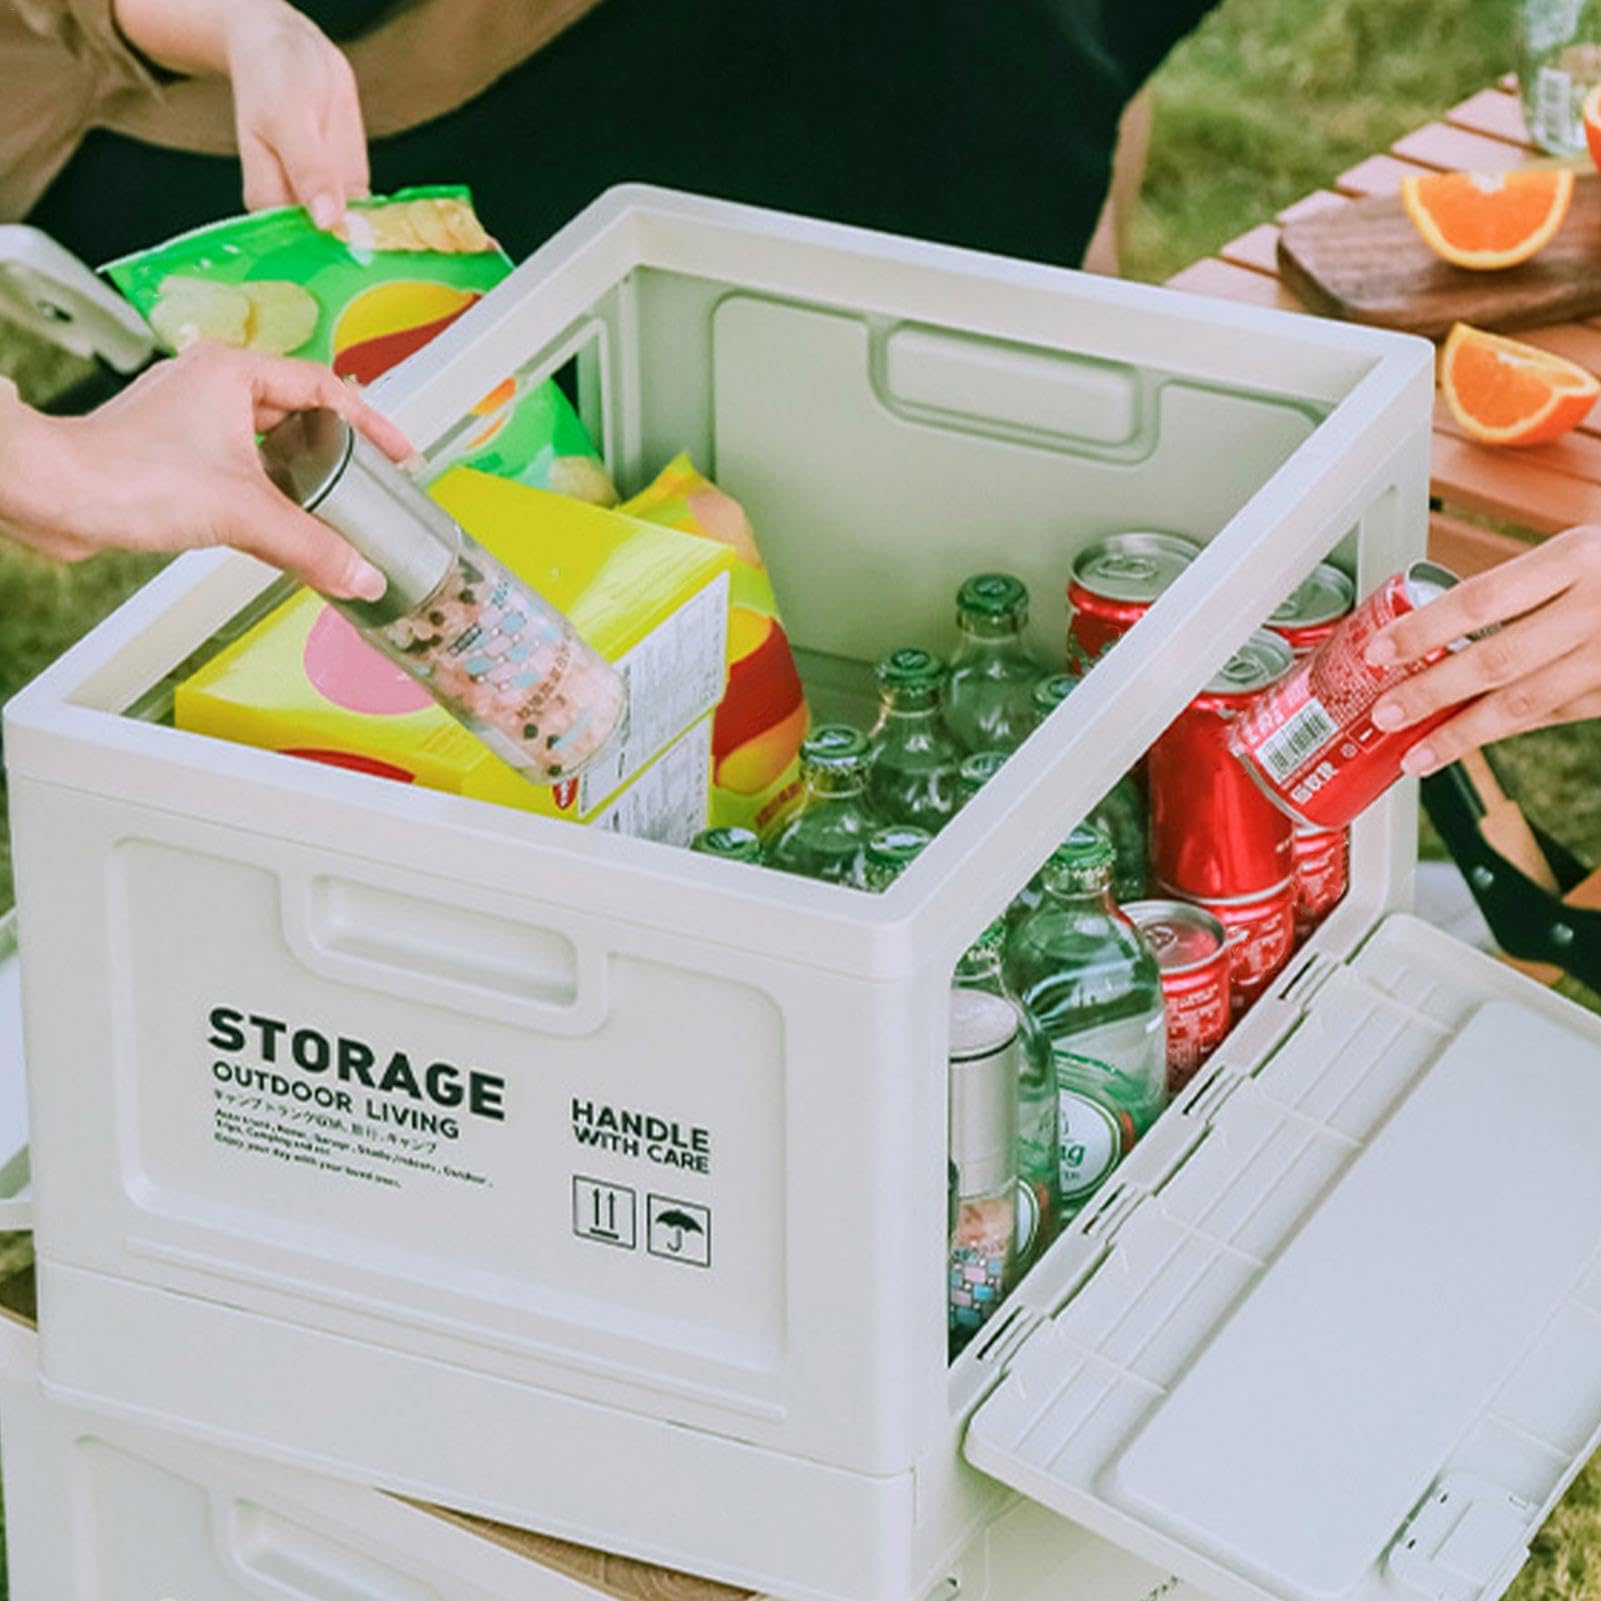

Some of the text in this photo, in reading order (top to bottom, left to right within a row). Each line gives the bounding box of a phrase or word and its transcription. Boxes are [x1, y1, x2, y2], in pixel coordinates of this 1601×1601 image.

[207, 1006, 505, 1121] STORAGE
[212, 1060, 460, 1140] OUTDOOR LIVING
[572, 1097, 710, 1154] HANDLE
[572, 1123, 710, 1175] WITH CARE
